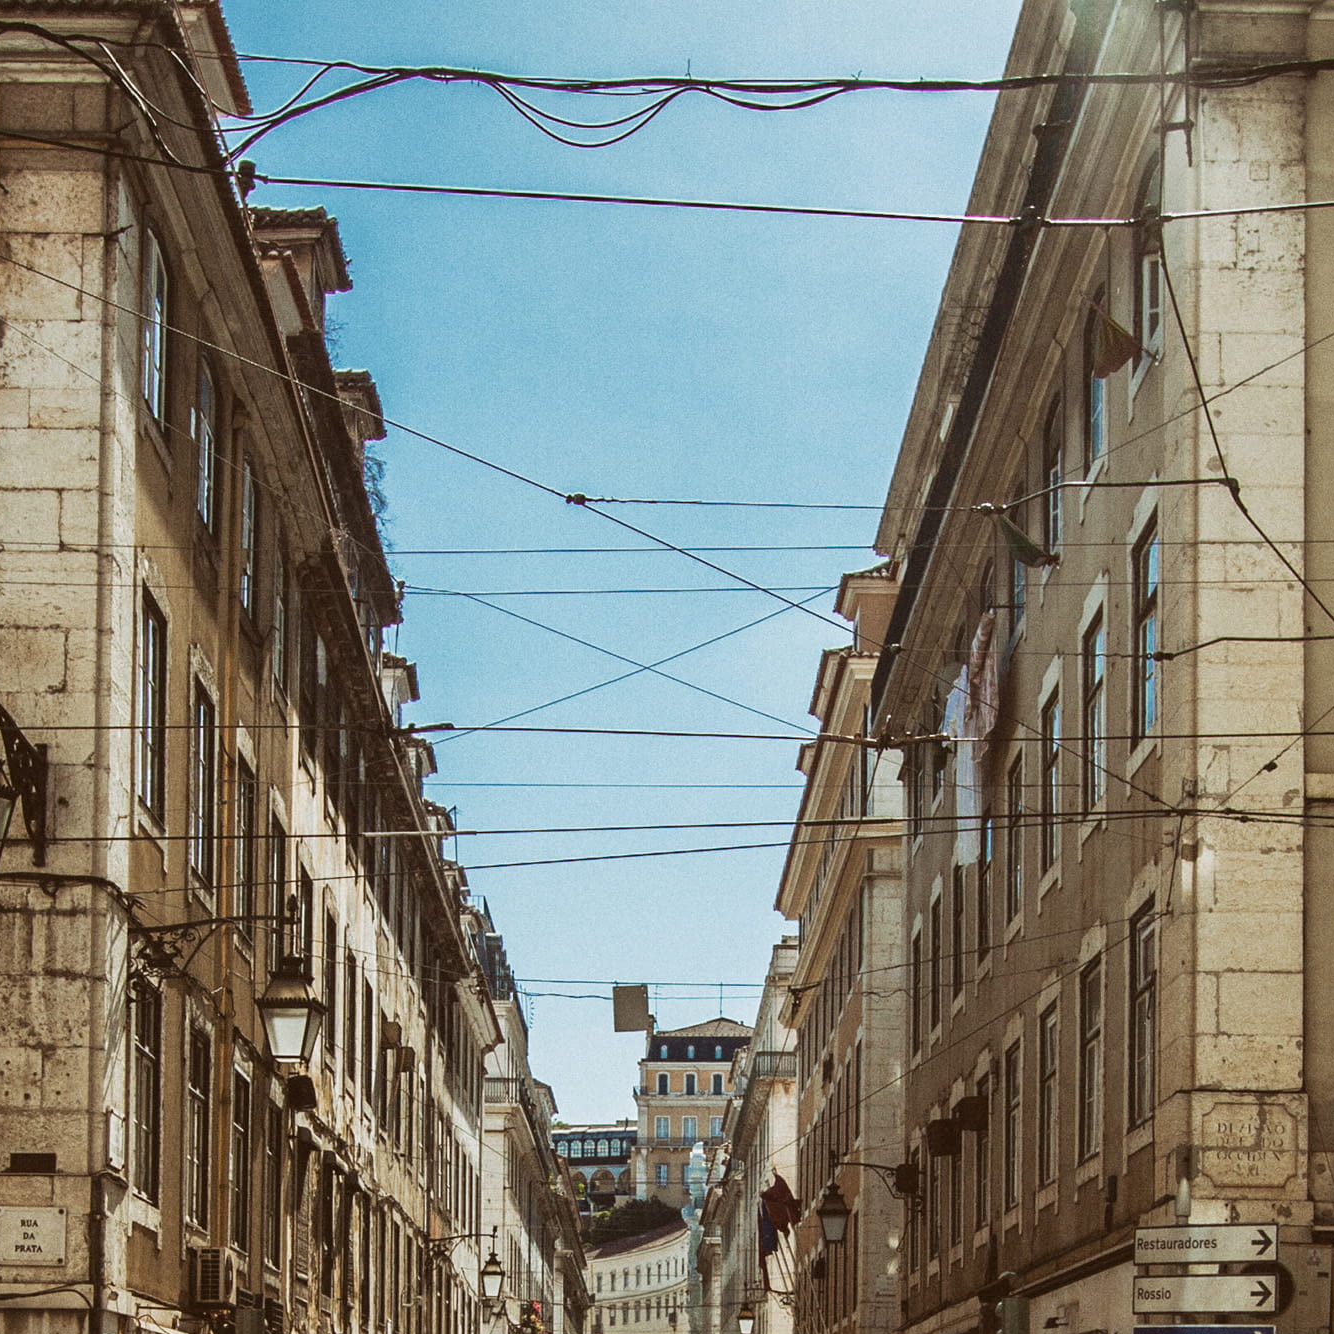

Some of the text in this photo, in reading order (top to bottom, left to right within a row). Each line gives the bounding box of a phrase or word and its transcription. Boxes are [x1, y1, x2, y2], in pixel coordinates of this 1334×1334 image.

[20, 1219, 39, 1228] RUA
[22, 1232, 36, 1240] DA
[1137, 1237, 1218, 1250] Restauradores
[14, 1244, 43, 1253] PRATA
[1137, 1287, 1171, 1300] Rossio
